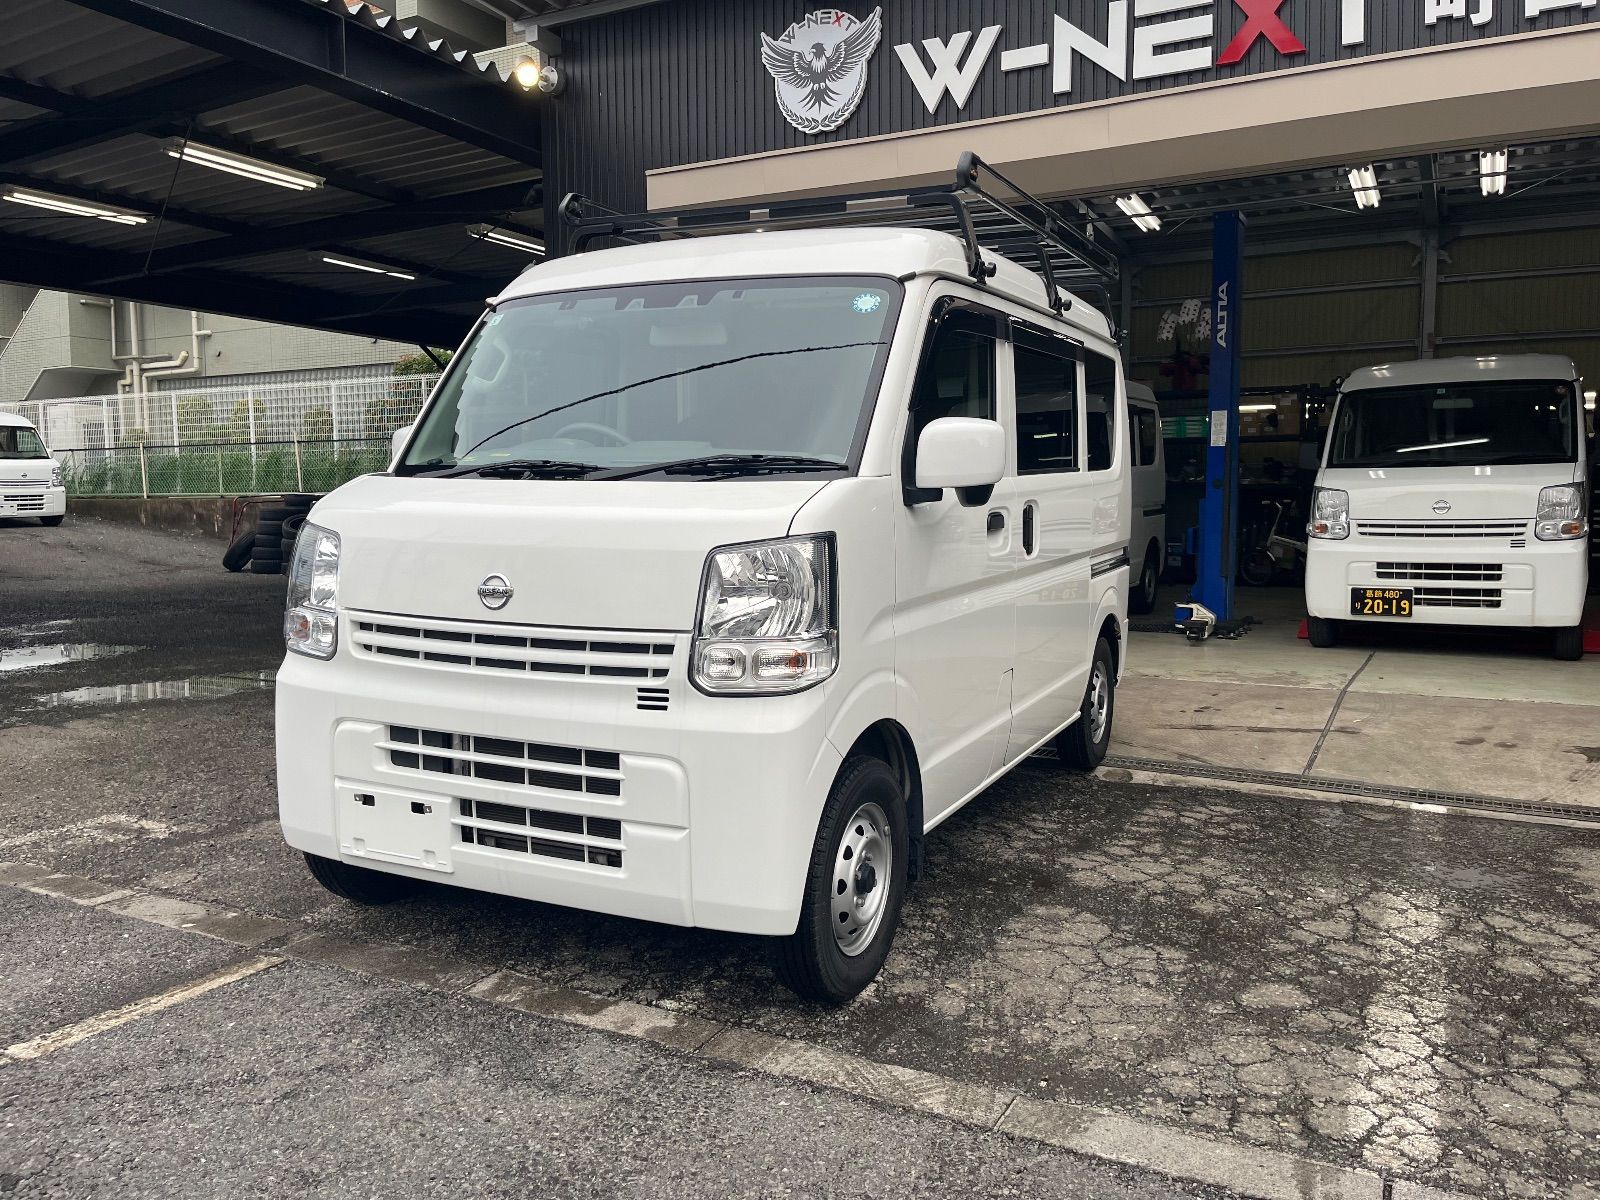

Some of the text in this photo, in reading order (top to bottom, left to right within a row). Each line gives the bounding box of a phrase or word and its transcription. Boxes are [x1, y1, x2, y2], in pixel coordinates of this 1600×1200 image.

[780, 11, 857, 45] W-NEXT
[1383, 590, 1400, 599] 480
[1363, 598, 1410, 615] 20-19
